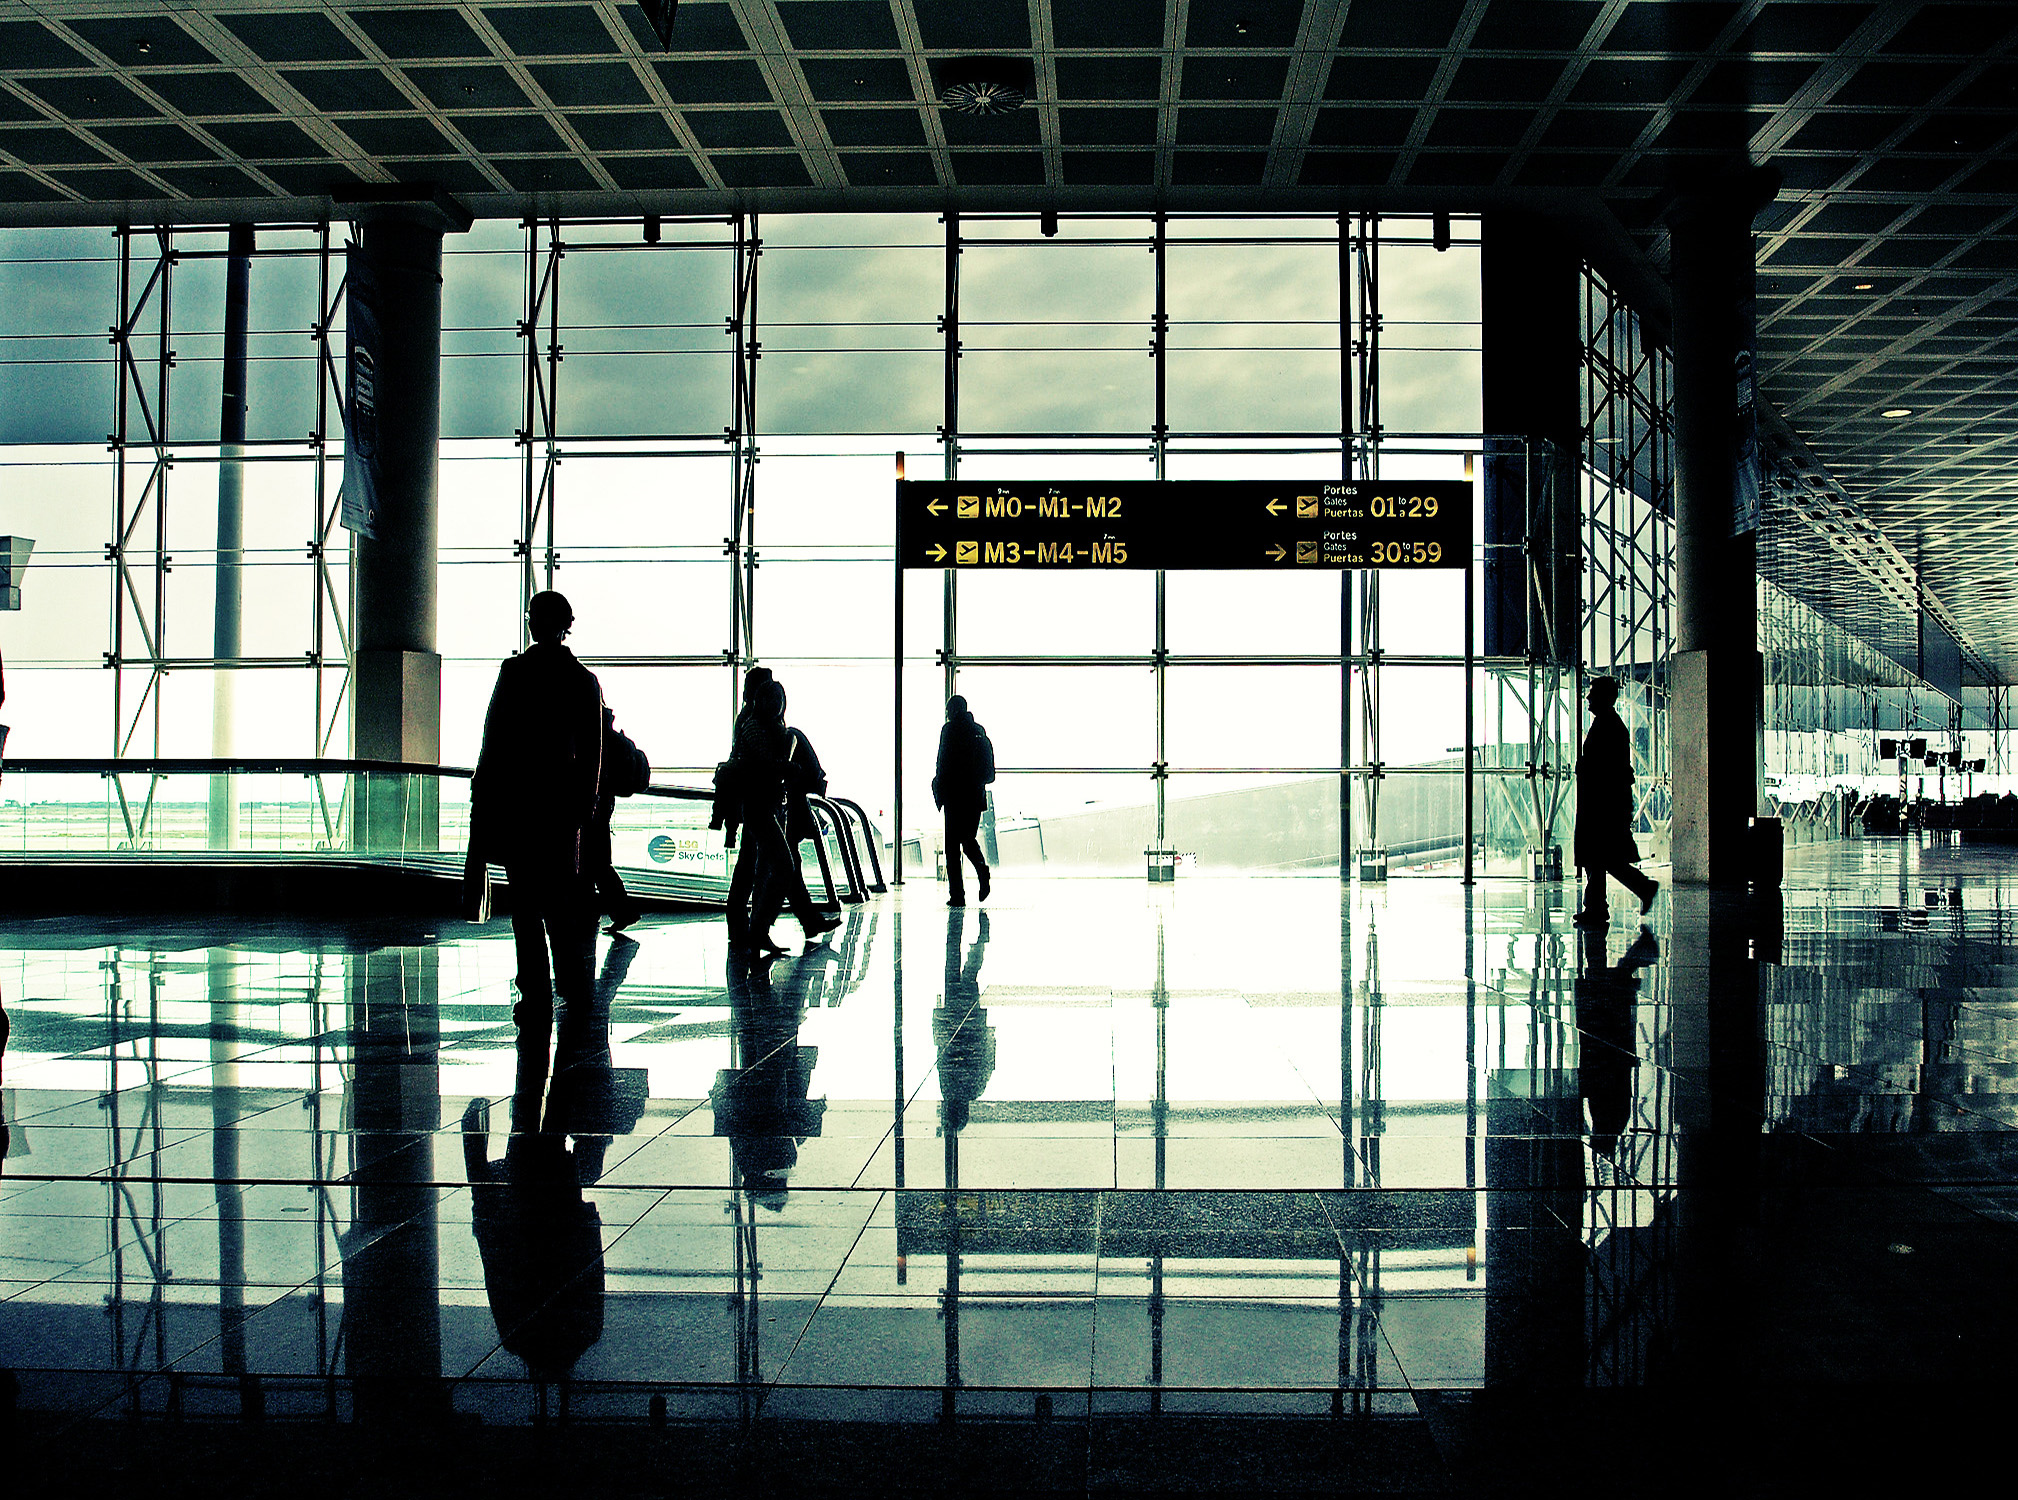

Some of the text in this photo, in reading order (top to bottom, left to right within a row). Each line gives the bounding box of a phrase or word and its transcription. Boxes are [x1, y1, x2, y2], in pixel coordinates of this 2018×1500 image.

[1323, 485, 1358, 495] Portes
[1323, 496, 1348, 506] Gates
[1398, 496, 1407, 505] to
[985, 496, 1122, 518] M0-M1-M2
[1324, 507, 1364, 518] Puertas
[1370, 496, 1397, 518] 01
[1408, 496, 1439, 518] 29
[1399, 509, 1406, 518] a
[1323, 530, 1358, 541] Portes
[1323, 541, 1347, 551] Gates
[1402, 542, 1411, 551] to
[984, 541, 1128, 564] M3-M4-M5
[1323, 553, 1364, 563] Puertas
[1370, 541, 1402, 564] 30
[1412, 541, 1442, 564] 59
[1403, 554, 1410, 563] a
[678, 851, 725, 862] Sky Chefs
